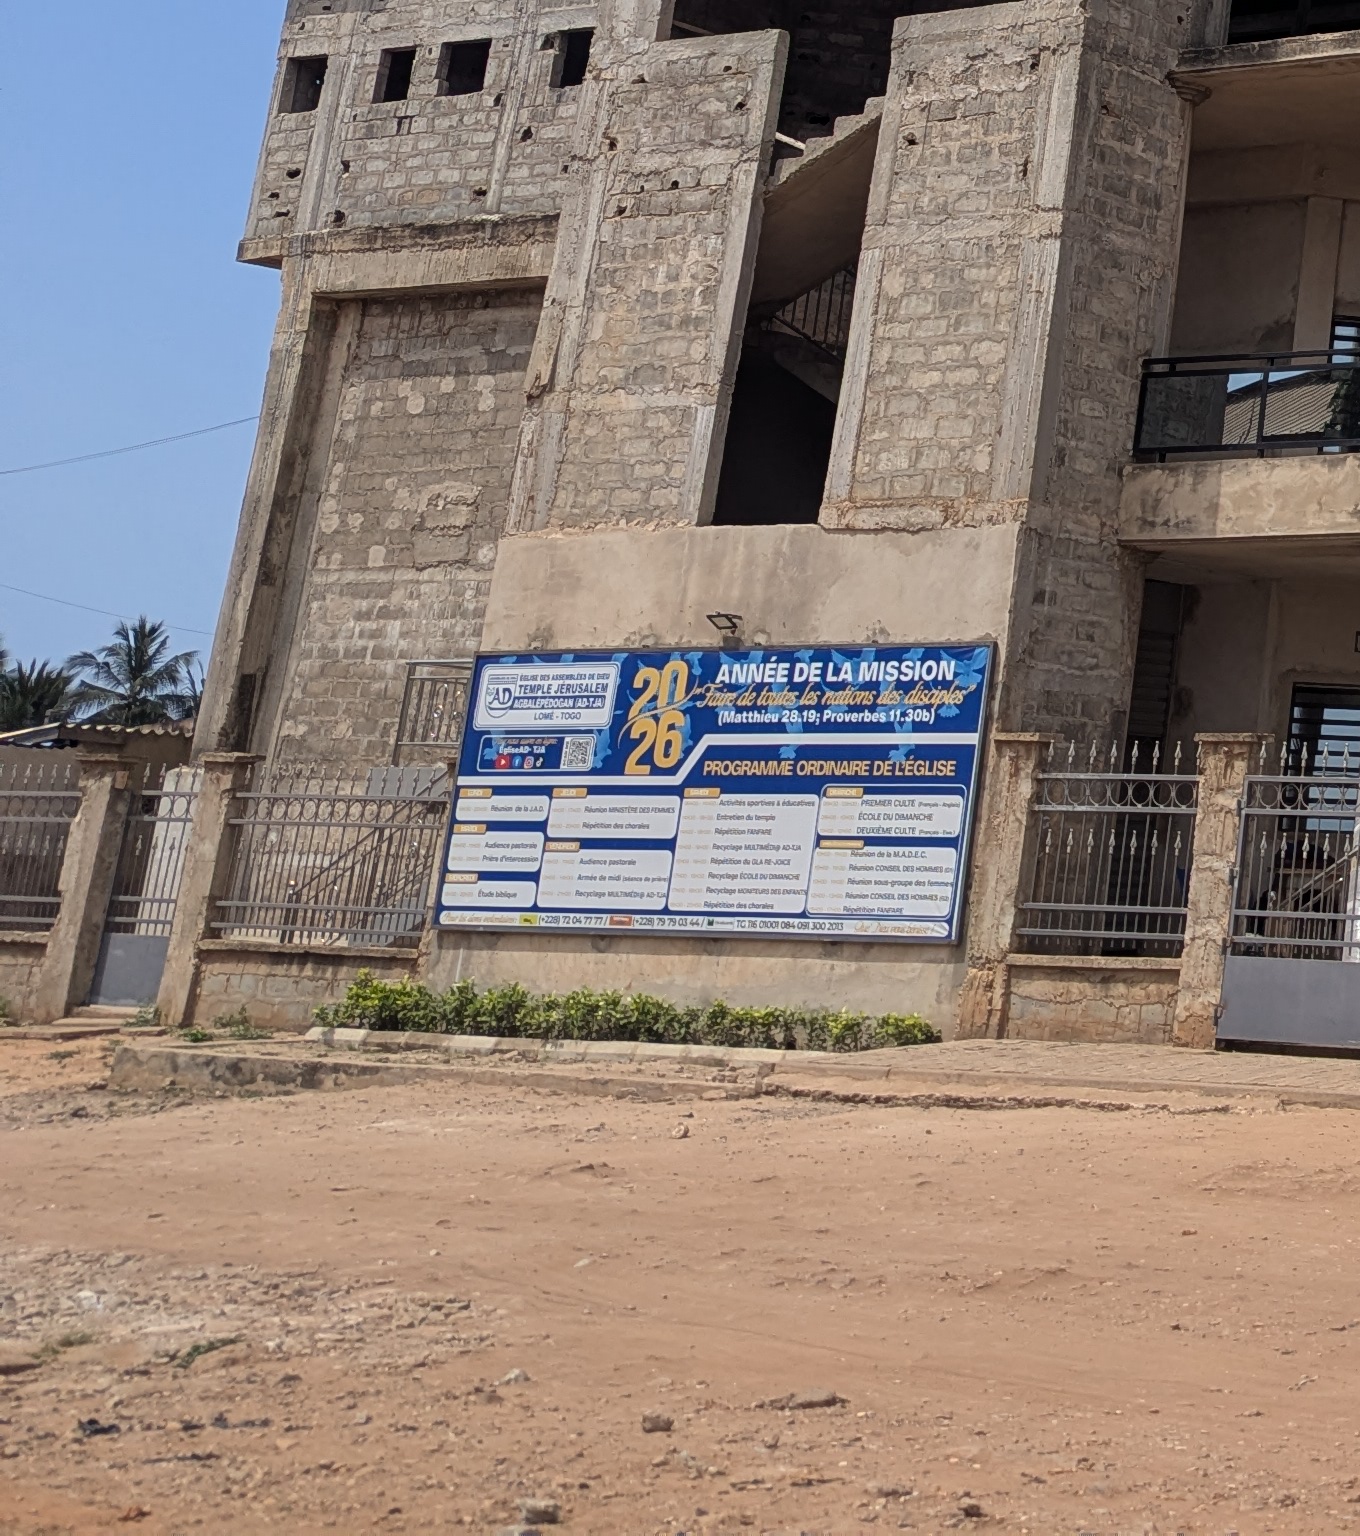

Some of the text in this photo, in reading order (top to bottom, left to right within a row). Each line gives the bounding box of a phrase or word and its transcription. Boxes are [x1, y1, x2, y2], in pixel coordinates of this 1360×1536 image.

[716, 657, 956, 684] ANNÉE DE LA MISSION
[520, 673, 539, 682] ÉGLISE
[551, 673, 586, 681] ASSEMBLÉES
[518, 681, 608, 695] TEMPLE JÉRUSALEM
[488, 687, 513, 705] AD
[740, 687, 756, 705] de
[758, 685, 797, 705] toutes
[800, 685, 820, 705] les
[821, 685, 873, 705] nations
[876, 683, 903, 705] des
[575, 696, 605, 709] (AD-TJA)
[534, 711, 581, 721] LOMÉ TOGO
[717, 708, 934, 726] (Matthieu 28.19; Proverbes 11.30b)
[624, 710, 684, 775] 26
[703, 755, 956, 777] PROGRAMME ORDINAIRE DE L'ÉGLISE
[584, 806, 608, 814] Réunion
[639, 806, 650, 814] DES
[858, 812, 881, 821] ÉCOLE
[582, 822, 612, 831] Répétition
[613, 822, 623, 830] des
[715, 828, 746, 836] Répétition
[484, 842, 509, 850] Audience
[579, 858, 607, 866] Audience
[708, 872, 738, 881] Recyclage
[740, 871, 758, 880] ÉCOLE
[478, 889, 494, 898] Étude
[704, 901, 734, 909] Répétition
[843, 905, 876, 914] Répétition
[538, 915, 603, 925] (+228) 72 04 77 77
[633, 917, 700, 927] (+228) 79 79 03 44
[736, 920, 746, 929] TG
[780, 921, 796, 930] 084
[811, 921, 827, 931] 300
[828, 921, 843, 931] 2013
